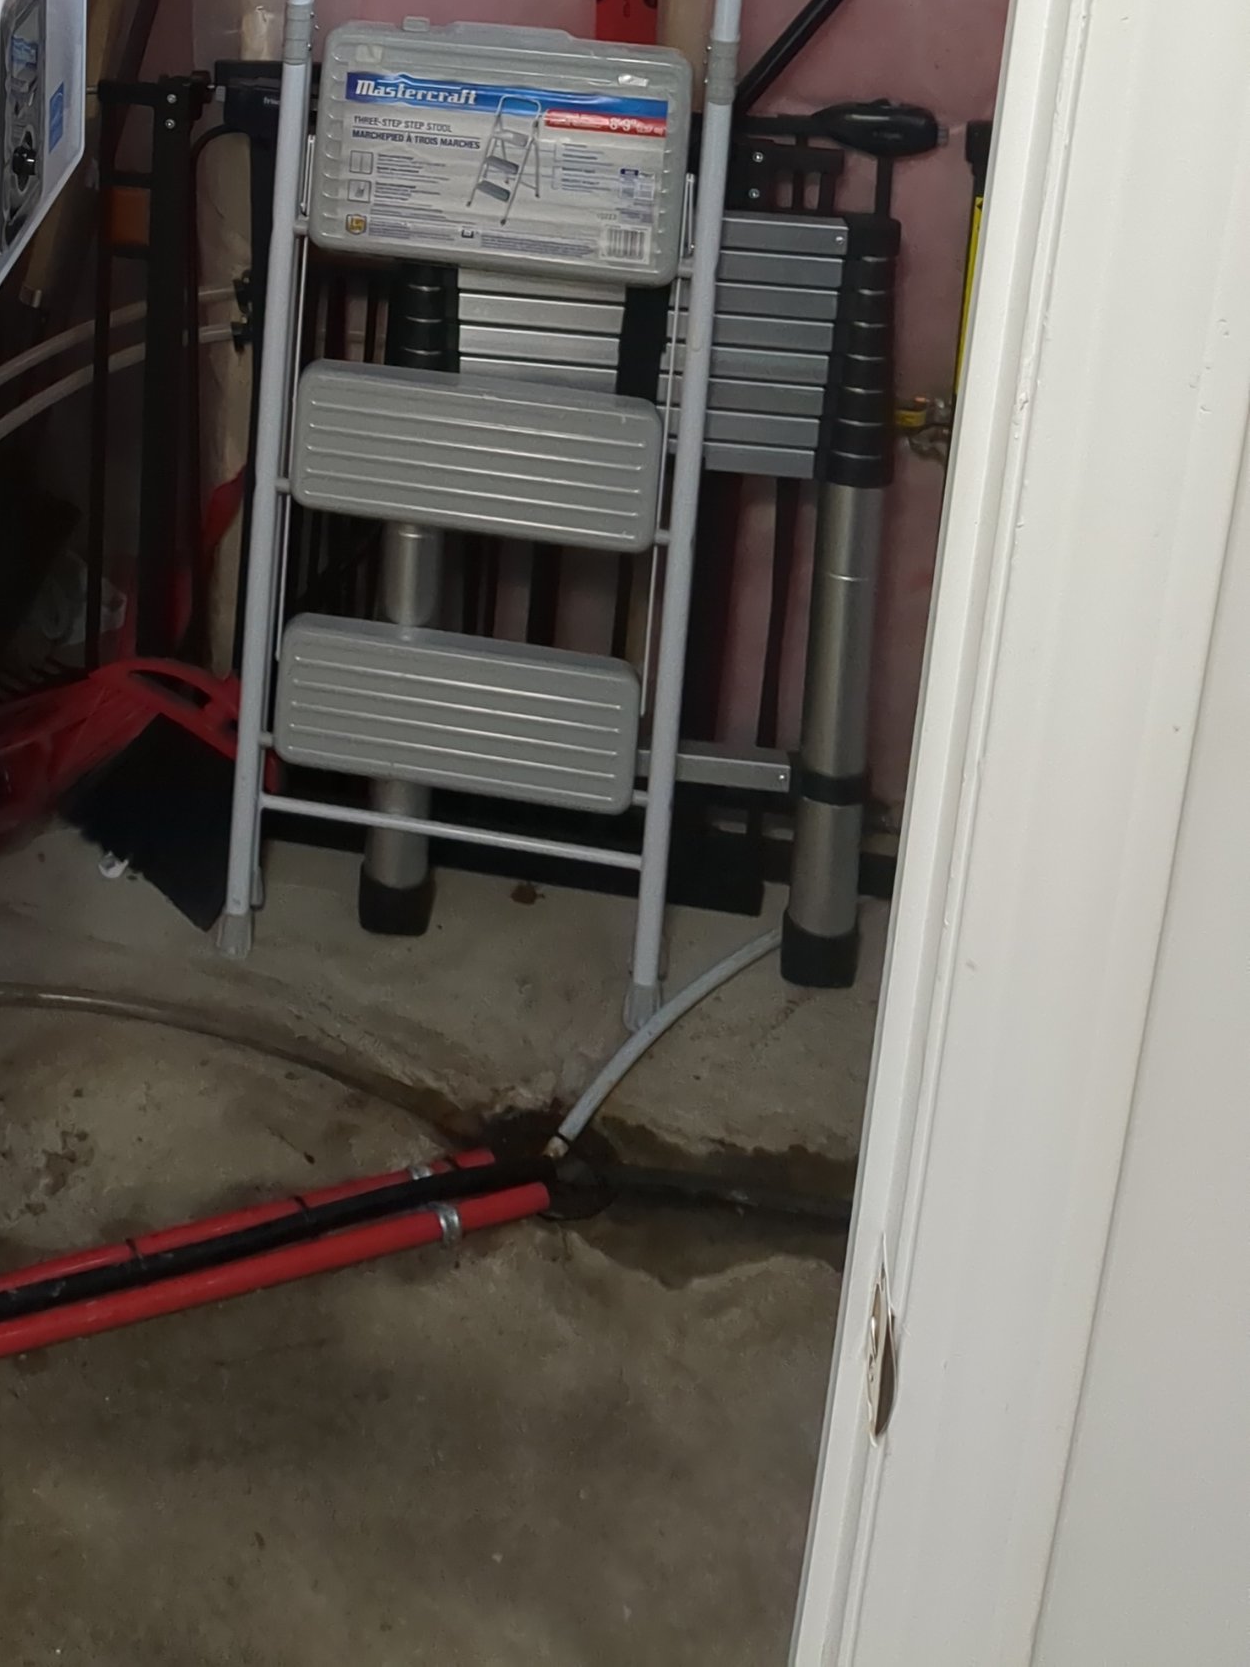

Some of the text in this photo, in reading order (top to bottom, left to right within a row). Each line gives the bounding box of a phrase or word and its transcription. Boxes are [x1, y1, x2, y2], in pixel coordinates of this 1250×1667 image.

[355, 79, 477, 105] Mastercraft
[353, 115, 453, 133] THREE-STEP STEP STOOL
[352, 129, 405, 143] MARCHEPIED
[414, 135, 439, 146] TROIS
[440, 138, 481, 150] MARCHES
